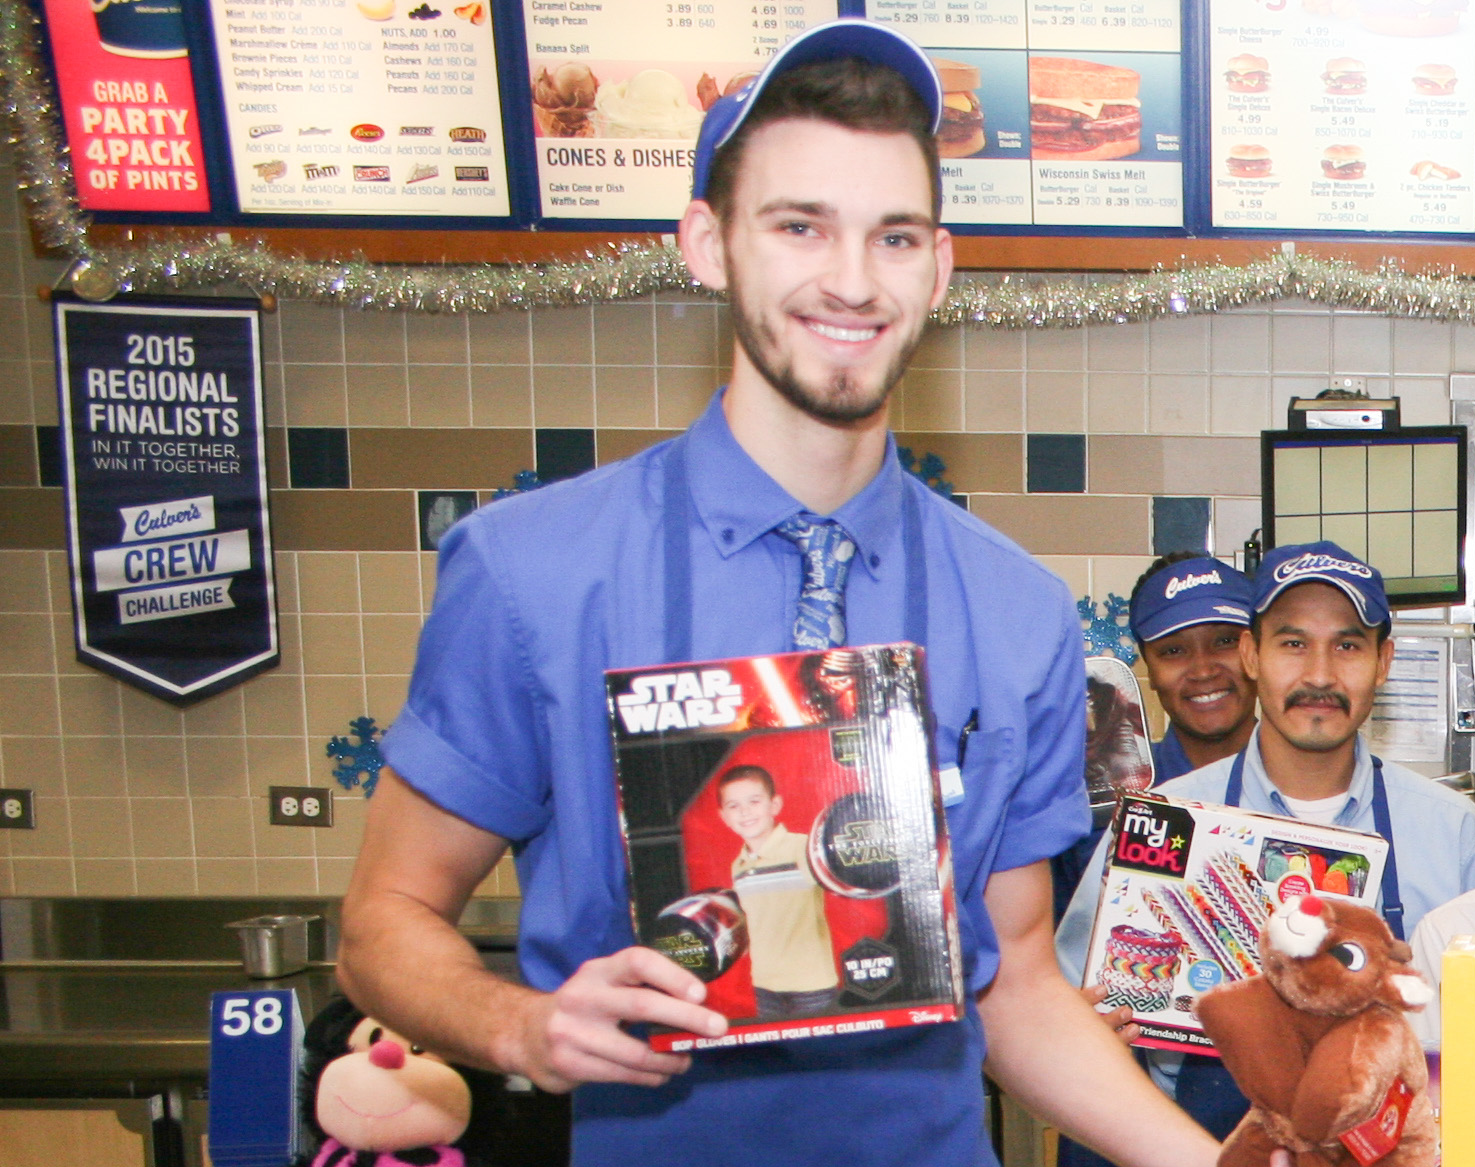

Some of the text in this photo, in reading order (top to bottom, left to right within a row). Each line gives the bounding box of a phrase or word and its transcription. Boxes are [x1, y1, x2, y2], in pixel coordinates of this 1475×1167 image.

[569, 2, 602, 12] Cashew
[667, 4, 691, 13] 3.89
[751, 6, 776, 15] 4.69
[533, 16, 777, 29] Fudge Pecan 3.89 4.69
[894, 13, 970, 24] 5.29 8.39
[1051, 16, 1126, 27] 3.29 6.39
[536, 43, 567, 53] Banana
[570, 44, 590, 55] Split
[94, 81, 168, 103] GRAB A
[239, 103, 277, 113] CANDIES
[81, 107, 188, 135] PARTY
[86, 139, 194, 166] 4PACK
[547, 148, 697, 168] CONES & DISHES
[90, 170, 198, 191] OF PINTS
[942, 167, 963, 178] Melt
[1039, 168, 1146, 180] Wisconsin Swiss Melt
[549, 183, 625, 193] Cake Cone or Dish
[551, 196, 600, 207] Waffle Cone
[952, 195, 977, 205] 8.39
[1056, 196, 1130, 207] 5.29 8.39
[127, 334, 195, 367] 2015
[88, 368, 238, 404] REGIONAL
[89, 404, 240, 438] FINALISTS
[92, 440, 240, 459] IN IT TOGETHER,
[93, 457, 240, 474] WIN IT TOGETHER
[134, 503, 203, 536] Culver's
[124, 538, 220, 584] CREW
[1165, 569, 1222, 599] Culver's
[126, 586, 223, 618] CHALLENGE
[618, 669, 742, 706] STAR
[618, 697, 743, 734] WARS
[1124, 813, 1168, 848] my
[1117, 831, 1183, 872] look
[846, 959, 859, 970] 10
[853, 967, 888, 980] 25 CM
[1199, 969, 1212, 979] 30
[222, 998, 283, 1036] 58
[908, 1010, 943, 1024] Disney
[744, 1031, 780, 1044] GANTS
[782, 1028, 811, 1040] POUR
[813, 1025, 835, 1036] SAC
[1140, 1026, 1188, 1042] Friendship
